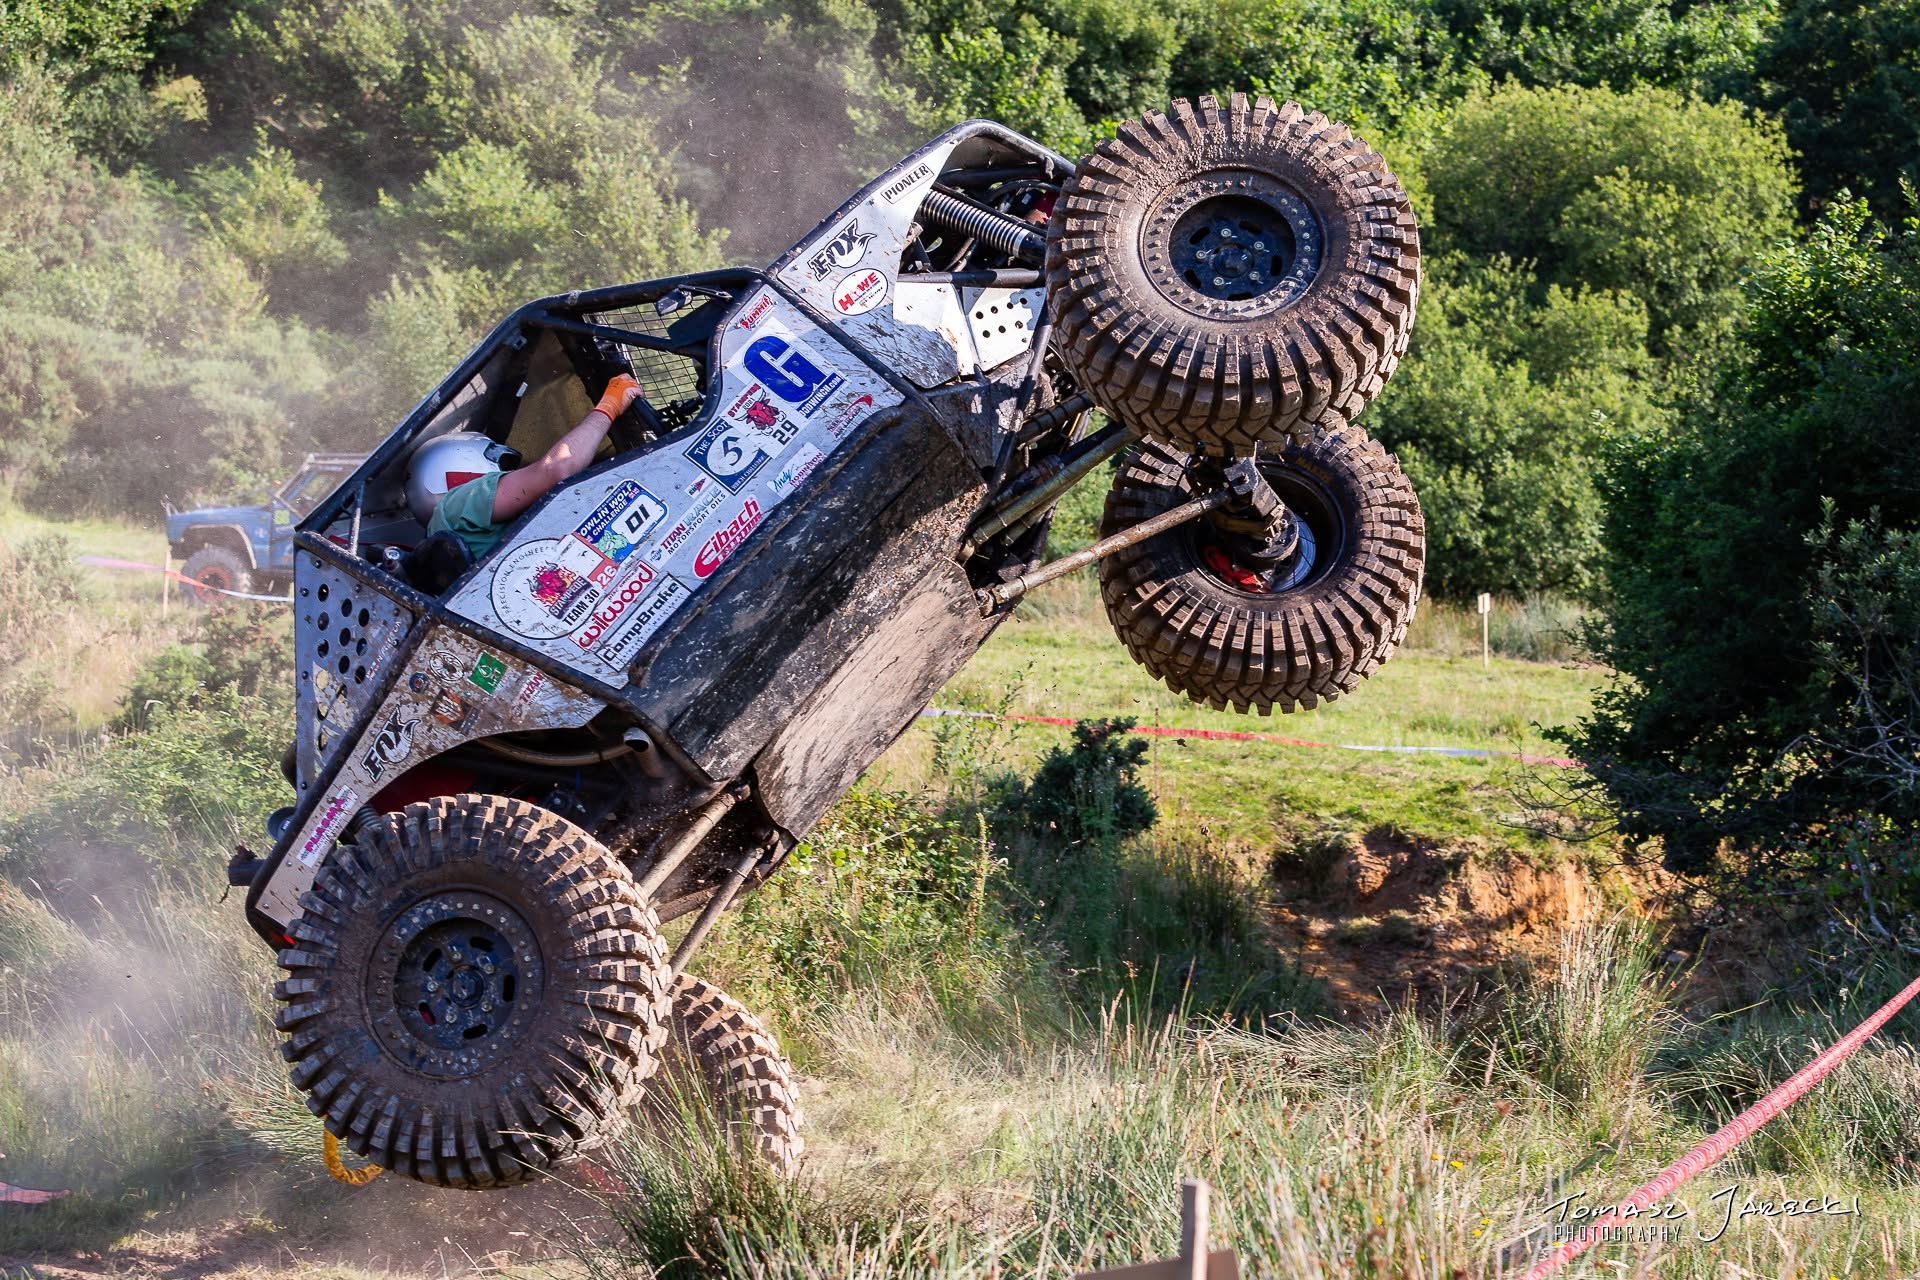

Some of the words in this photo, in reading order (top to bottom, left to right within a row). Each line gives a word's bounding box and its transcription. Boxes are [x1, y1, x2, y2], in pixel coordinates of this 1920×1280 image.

[884, 164, 929, 200] PIONEER
[806, 217, 877, 281] FOX
[739, 295, 771, 329] SUMMIT
[743, 336, 827, 402] G
[741, 396, 755, 410] 2021
[694, 438, 710, 455] THE
[706, 419, 729, 441] SCOT
[771, 418, 799, 445] 29
[576, 506, 610, 536] OWLIN
[607, 482, 635, 508] WOLF
[591, 498, 628, 536] CHALLENGE
[659, 522, 686, 550] TITAN
[681, 484, 721, 527] RACE
[666, 508, 710, 555] MOTORSPORT
[709, 492, 726, 509] OILS
[694, 499, 758, 577] Eibach
[499, 569, 510, 612] PRECISION
[549, 575, 588, 617] STAMPEDE
[594, 563, 618, 589] 26
[562, 599, 588, 627] TEAM
[583, 587, 600, 604] 30
[576, 562, 653, 650] wilwood
[602, 581, 679, 662] CompBrake
[518, 670, 544, 703] TITAN
[359, 703, 420, 783] FOX
[303, 796, 344, 852] PLASMA
